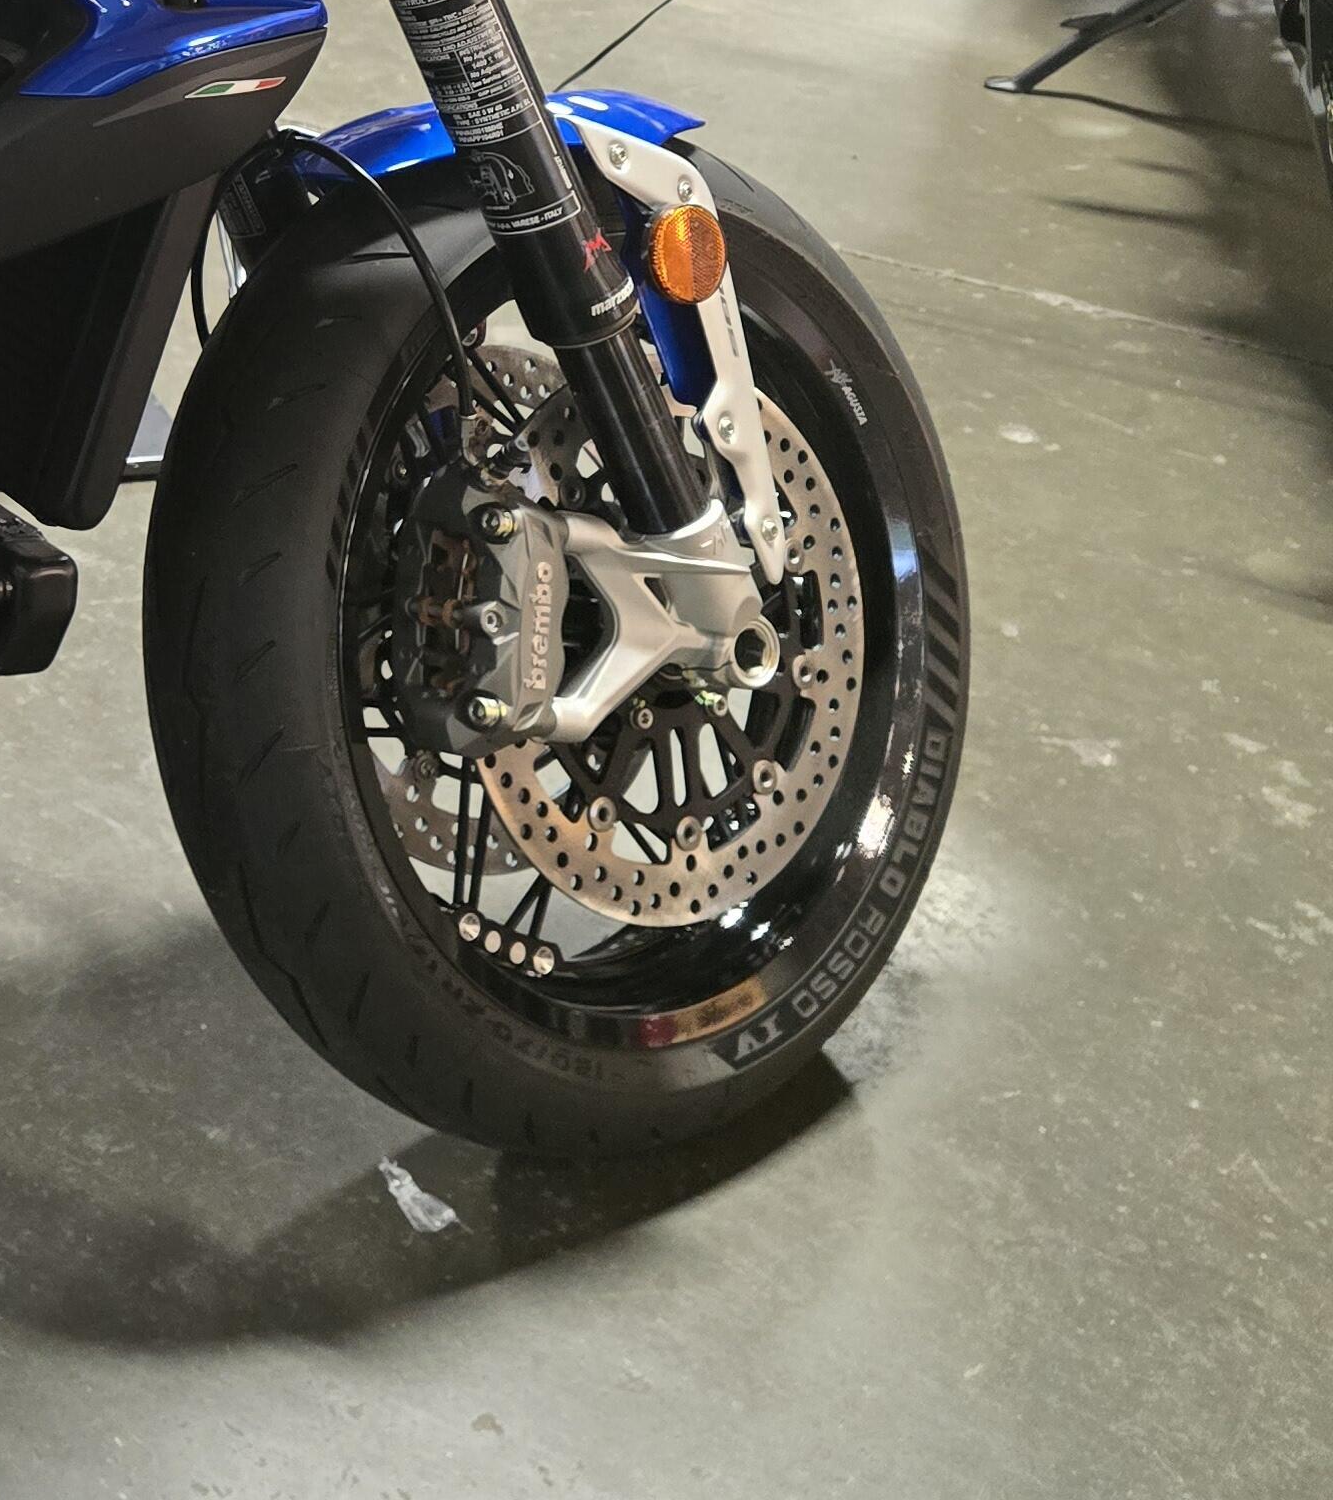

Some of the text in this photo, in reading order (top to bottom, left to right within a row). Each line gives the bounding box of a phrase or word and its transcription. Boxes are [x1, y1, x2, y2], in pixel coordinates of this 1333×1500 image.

[841, 386, 868, 426] AGUSTA
[524, 560, 553, 690] brembo
[879, 729, 954, 899] DIABLO
[793, 905, 889, 1019] ROSSO
